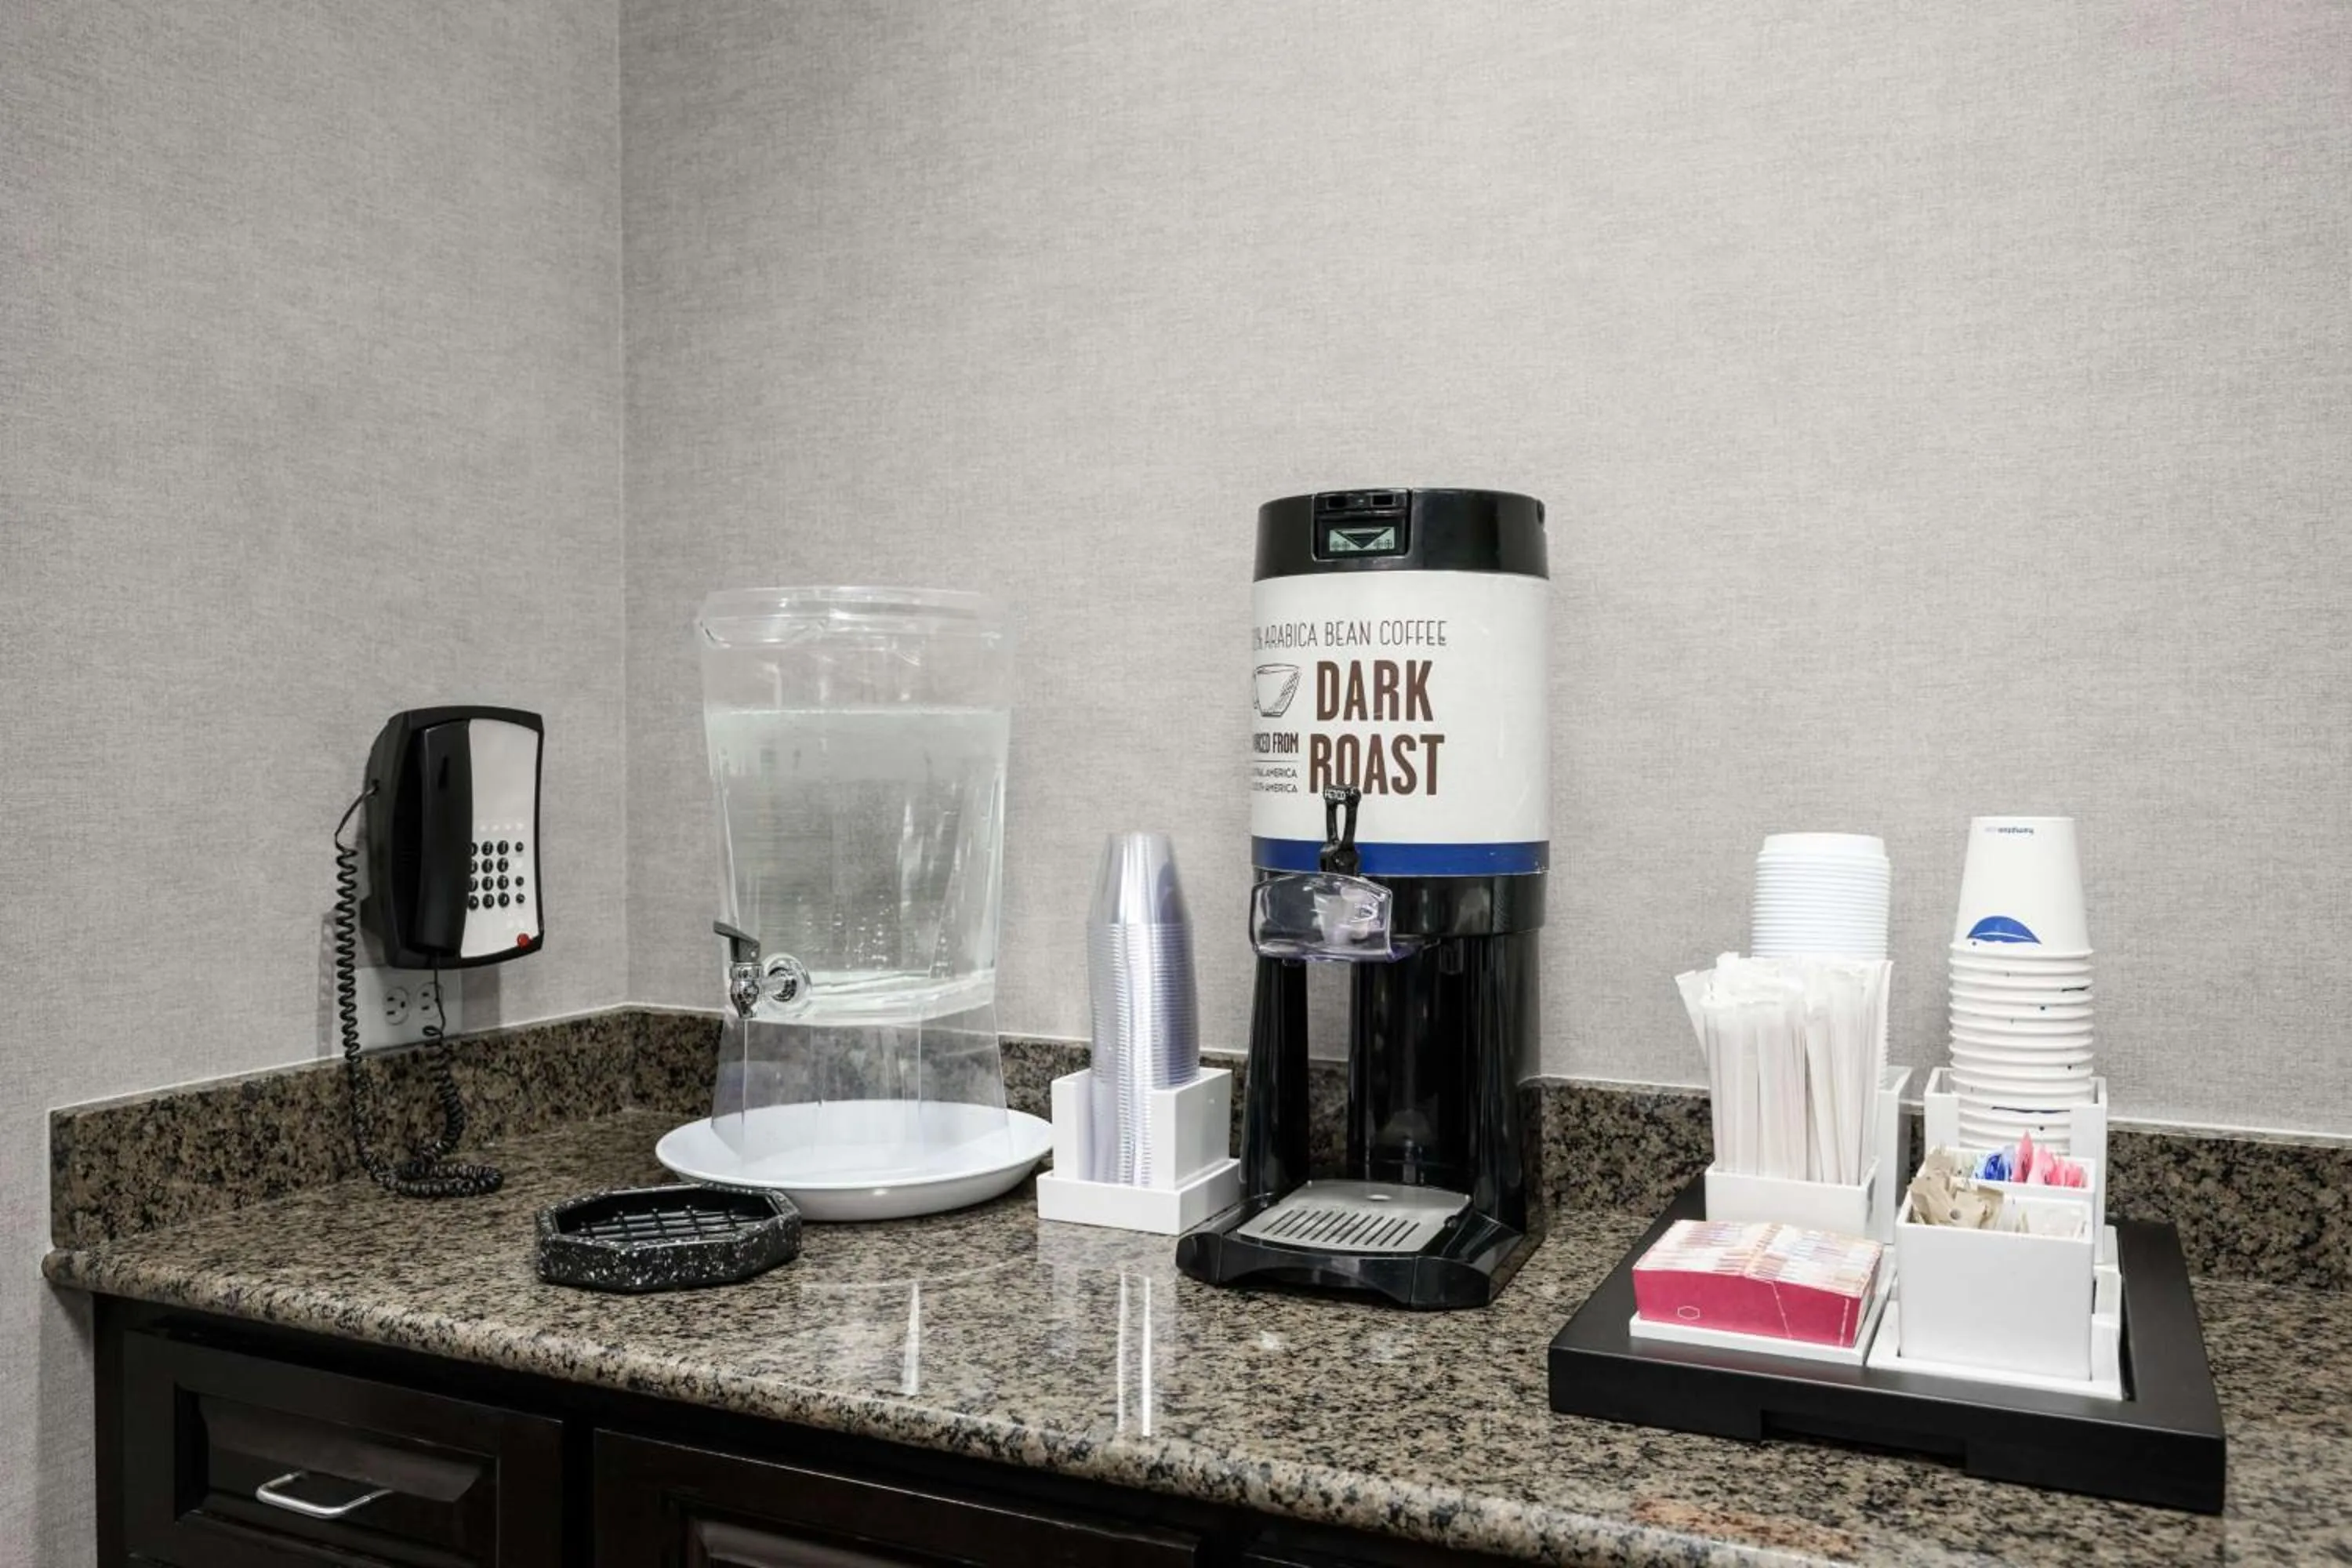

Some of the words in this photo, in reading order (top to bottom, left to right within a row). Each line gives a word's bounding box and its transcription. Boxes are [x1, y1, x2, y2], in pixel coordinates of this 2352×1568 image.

[1325, 620, 1371, 647] BEAN
[1379, 619, 1447, 646] COFFEE
[1316, 659, 1434, 721] DARK
[1272, 732, 1299, 753] FROM
[1309, 733, 1445, 795] ROAST
